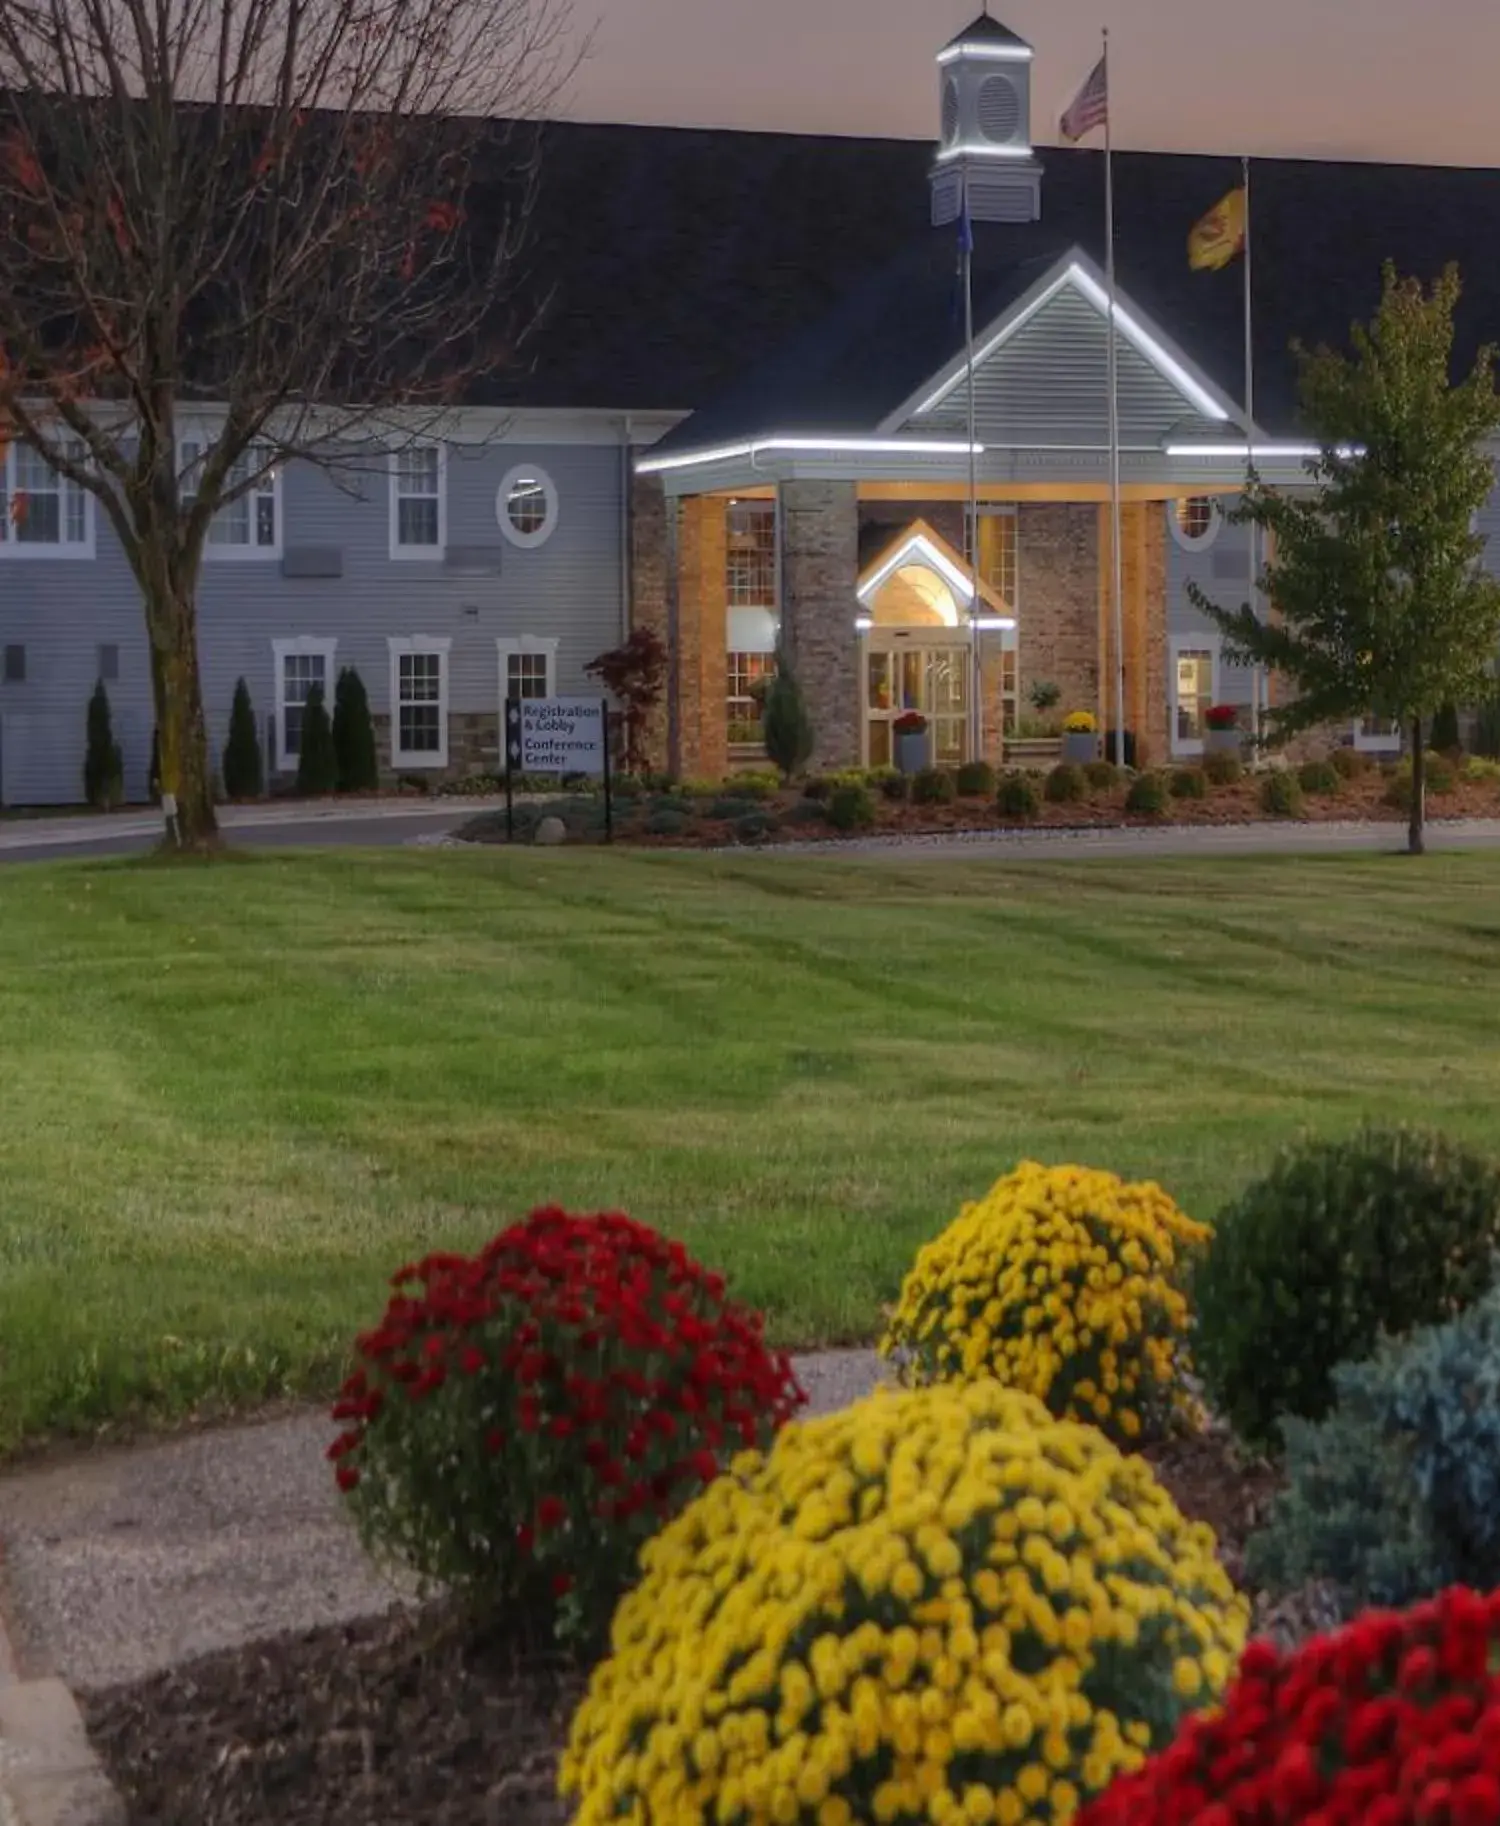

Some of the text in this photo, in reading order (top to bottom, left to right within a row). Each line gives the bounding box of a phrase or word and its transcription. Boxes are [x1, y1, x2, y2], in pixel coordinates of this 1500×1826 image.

[523, 705, 600, 720] Registration
[536, 719, 576, 735] Lobby
[524, 738, 597, 751] Conference
[525, 753, 567, 764] Center
